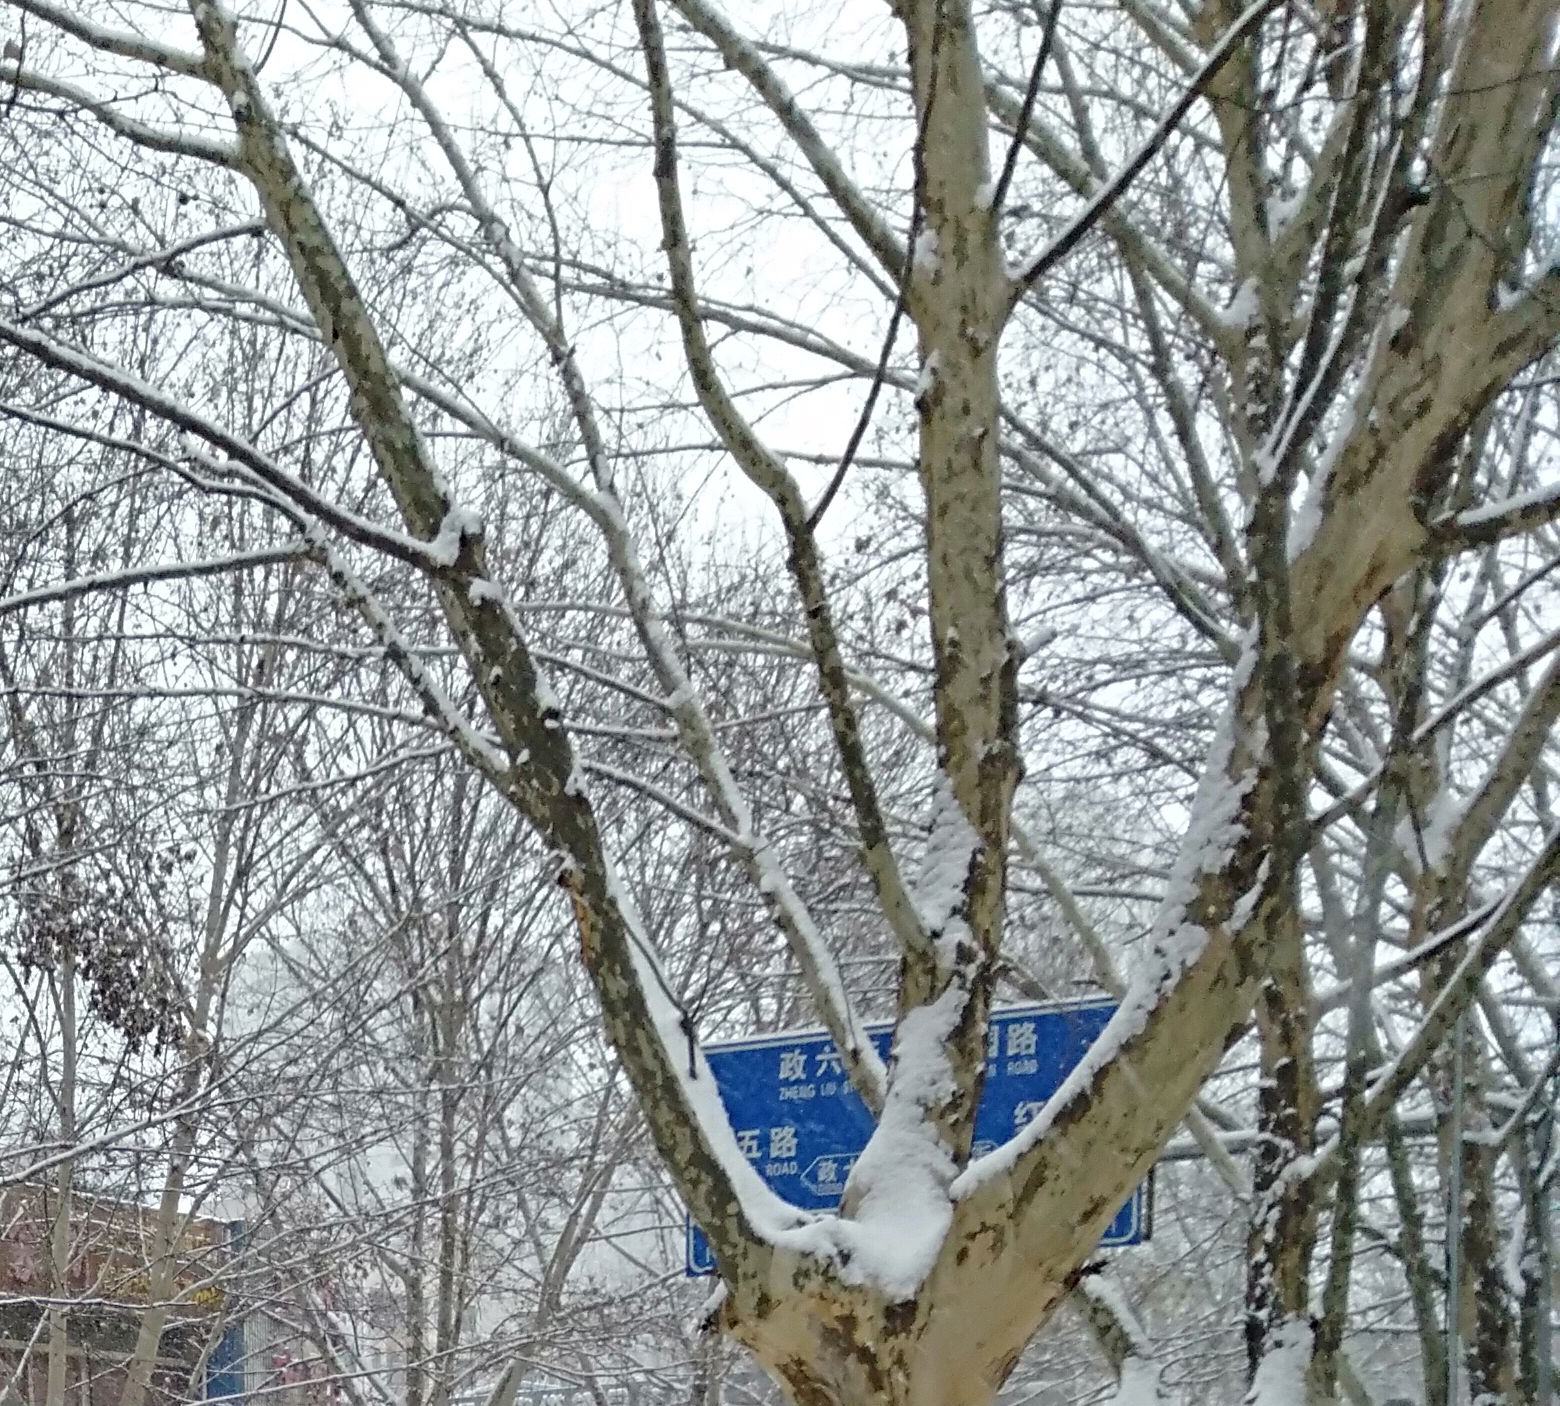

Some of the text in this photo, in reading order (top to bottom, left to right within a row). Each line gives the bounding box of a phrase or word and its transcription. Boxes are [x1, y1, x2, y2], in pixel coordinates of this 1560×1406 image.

[778, 1084, 817, 1101] ZHENG
[736, 1126, 799, 1160] 五路
[765, 1161, 799, 1178] ROAD
